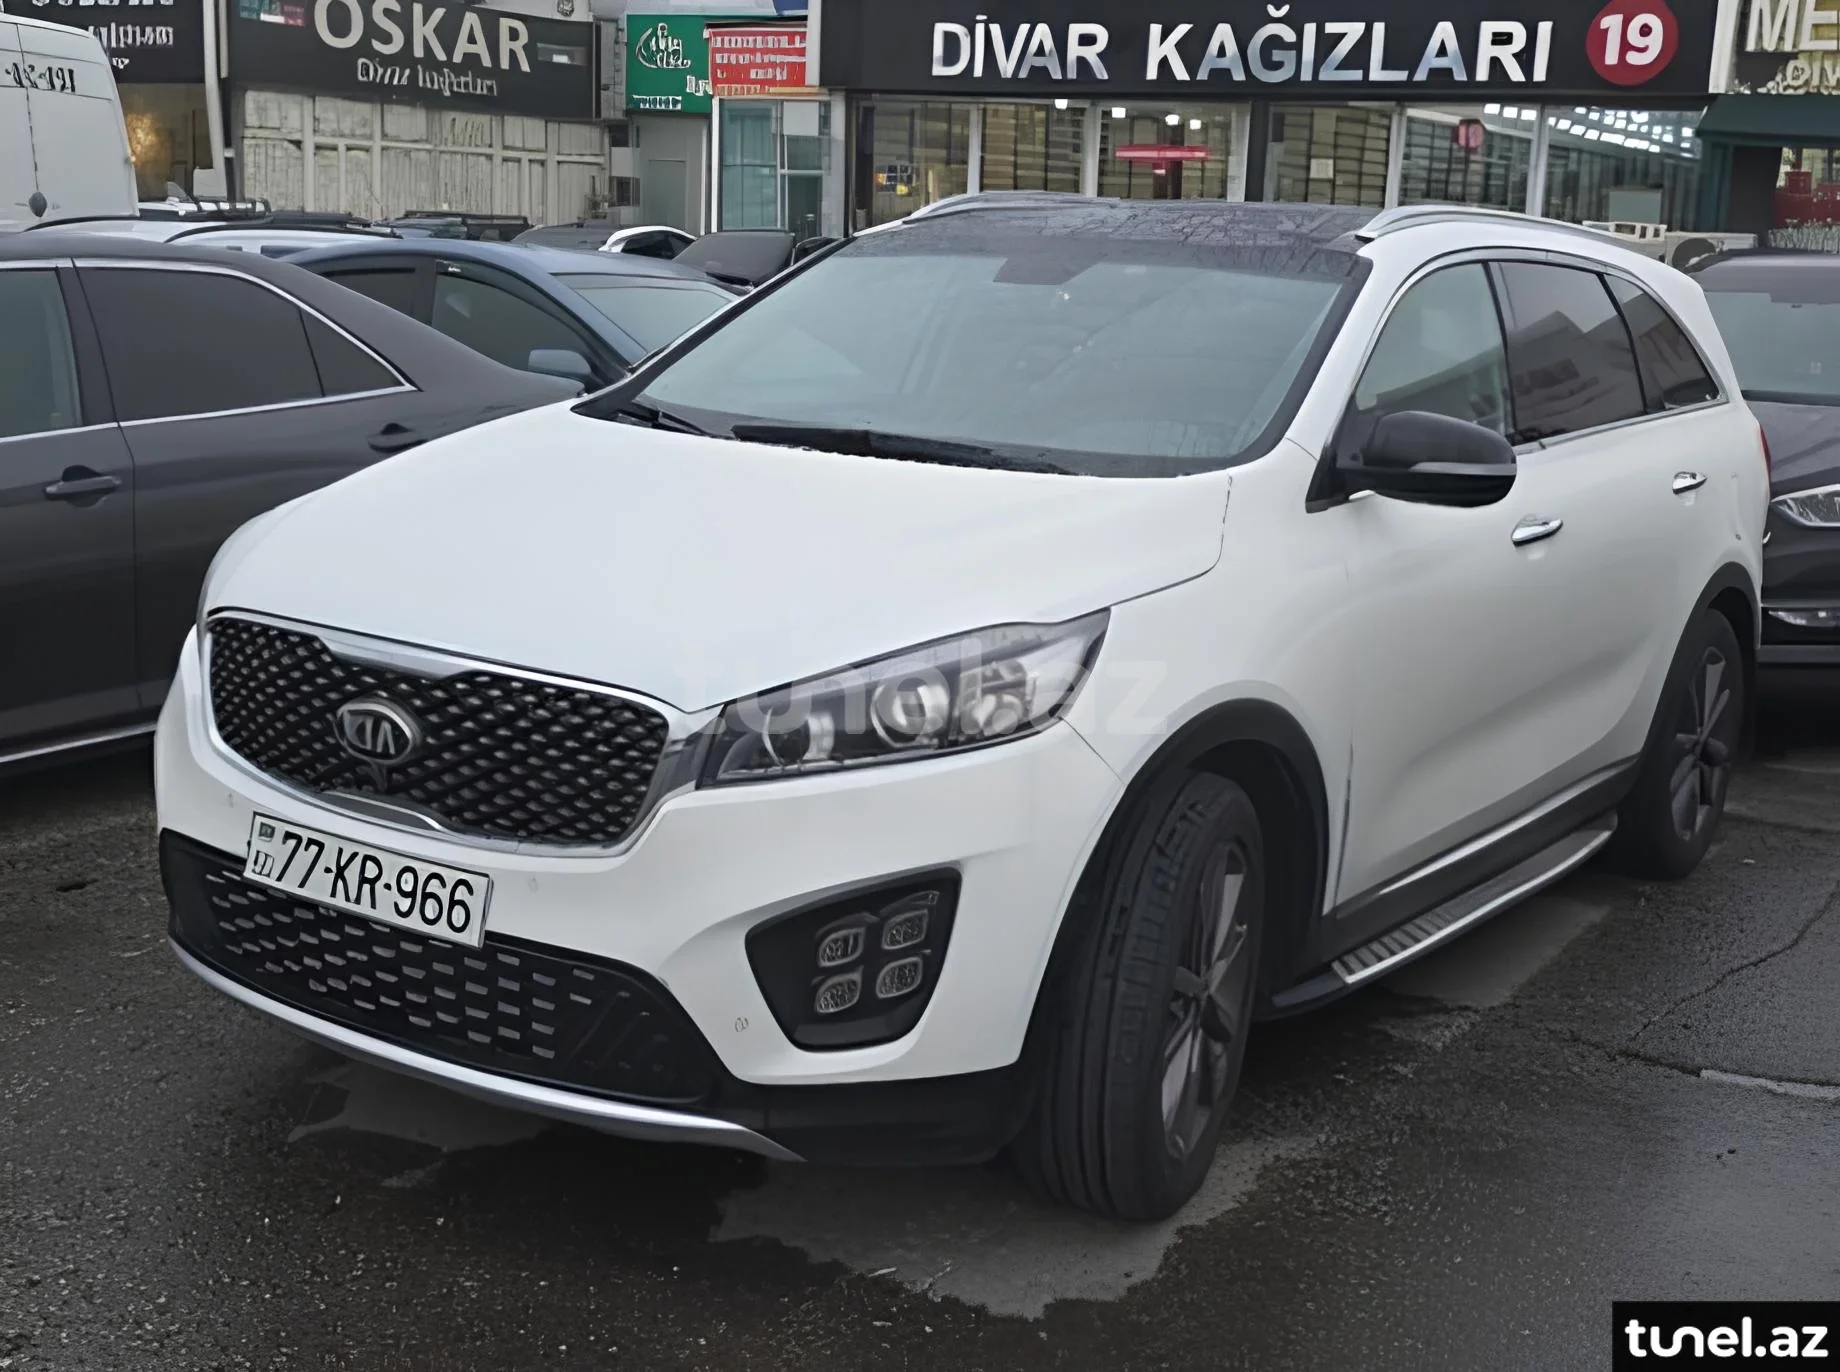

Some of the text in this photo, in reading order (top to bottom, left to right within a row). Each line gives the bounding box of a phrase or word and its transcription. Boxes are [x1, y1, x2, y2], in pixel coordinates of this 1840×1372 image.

[313, 0, 532, 73] OSKAR
[932, 4, 1664, 83] DİVAR KAĞIZLARI 19
[274, 829, 474, 934] 77-KR-966
